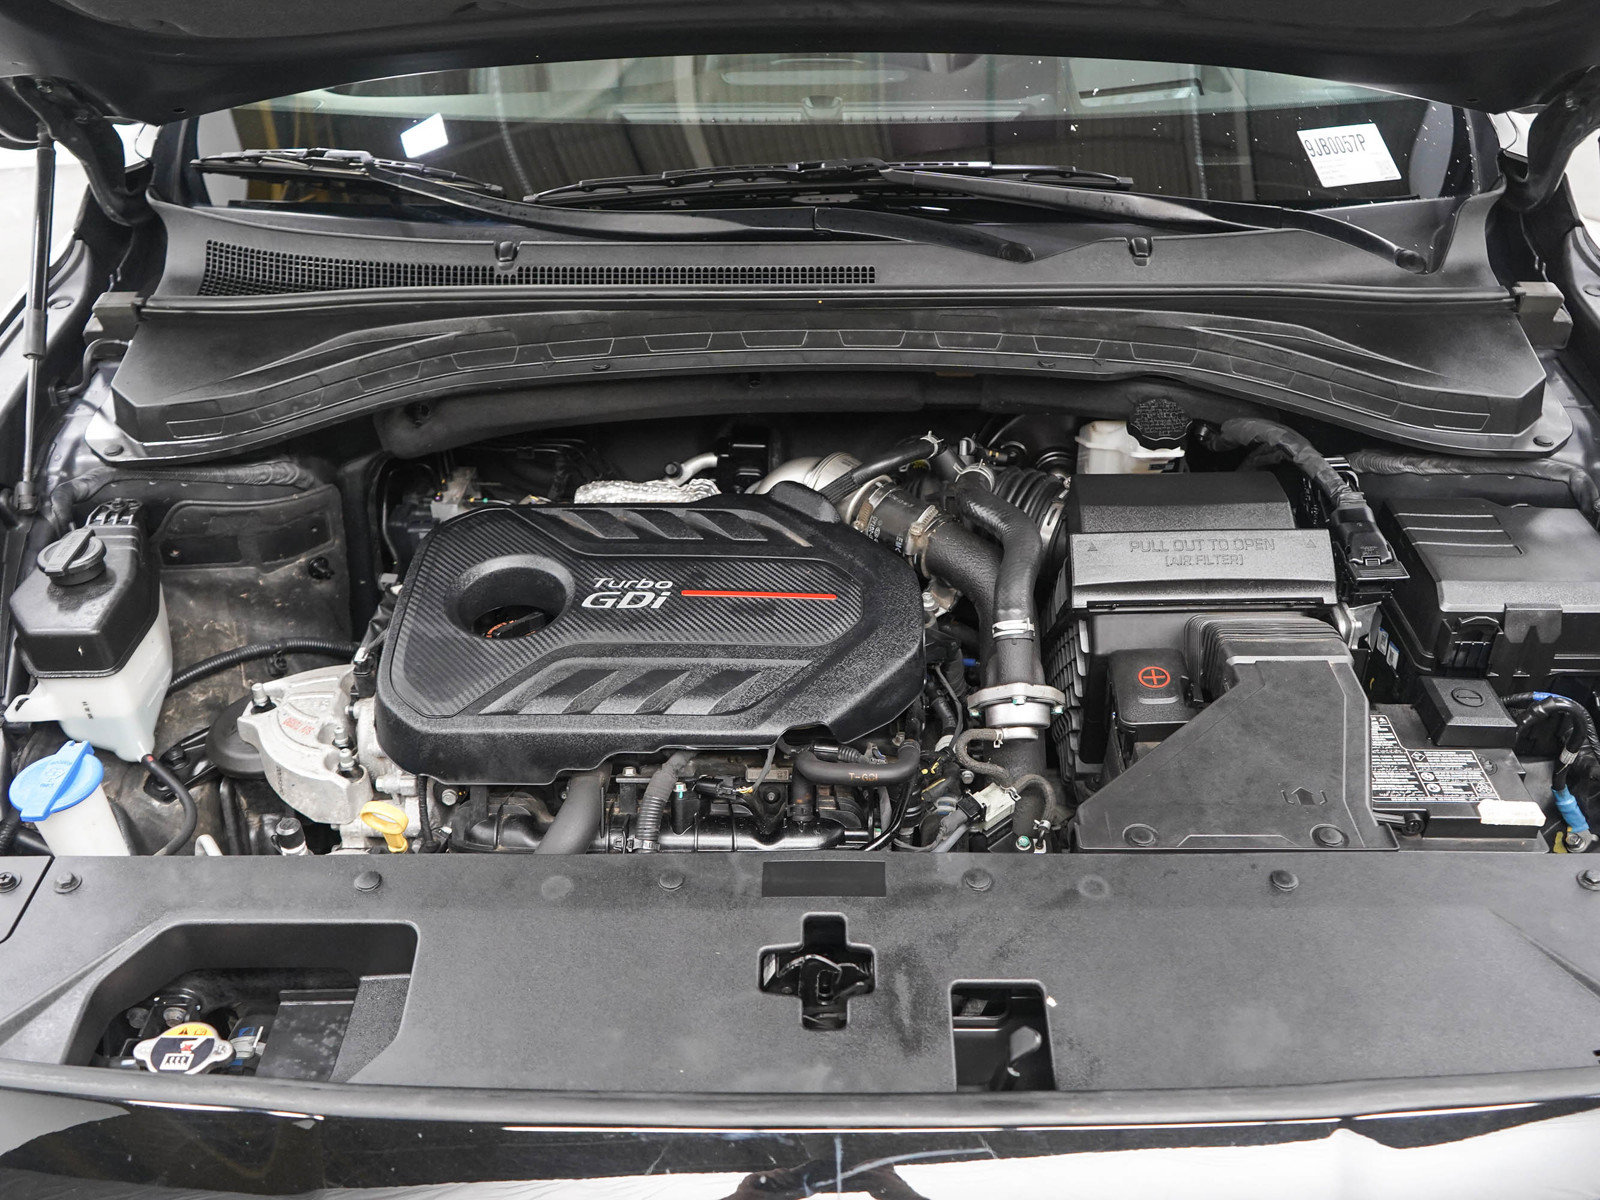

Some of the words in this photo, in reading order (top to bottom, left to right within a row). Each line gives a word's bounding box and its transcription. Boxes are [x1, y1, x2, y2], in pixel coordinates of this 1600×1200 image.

[1304, 133, 1366, 157] 9JB0057P
[1129, 540, 1170, 553] PULL
[1173, 539, 1204, 552] OUT
[1208, 538, 1229, 551] TO
[1233, 537, 1275, 551] OPEN
[593, 577, 674, 589] Turbo
[581, 591, 672, 609] GDi
